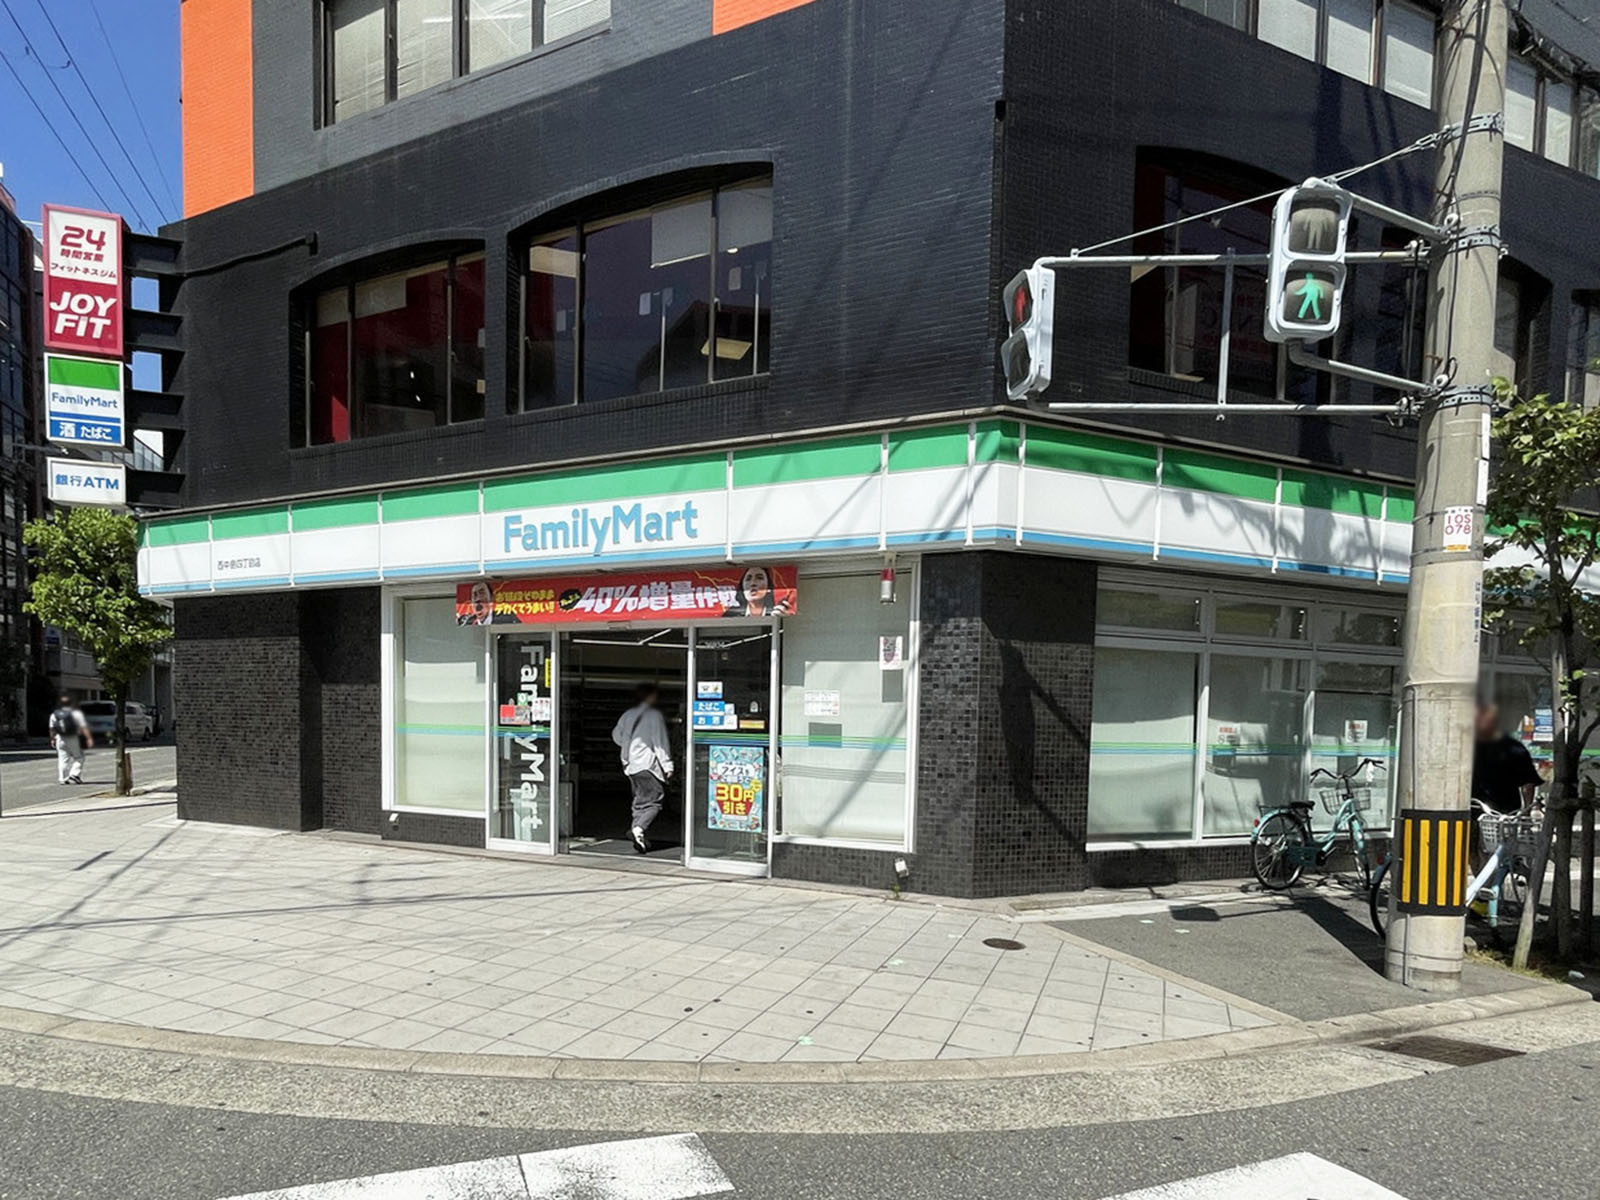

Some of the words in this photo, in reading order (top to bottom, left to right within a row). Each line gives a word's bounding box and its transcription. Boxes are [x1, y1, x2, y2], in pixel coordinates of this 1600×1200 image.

[60, 225, 106, 251] 24
[51, 262, 116, 278] フィットネスジム
[49, 291, 117, 317] JOY
[51, 392, 118, 409] FamilyMart
[59, 422, 75, 438] 酒
[80, 425, 112, 440] たばこ
[55, 474, 119, 490] 銀行ATM
[504, 500, 698, 557] FamilyMart
[1445, 524, 1471, 535] 078
[576, 581, 740, 614] 40%増量作戦
[716, 783, 754, 803] 30円
[723, 802, 746, 815] 引き
